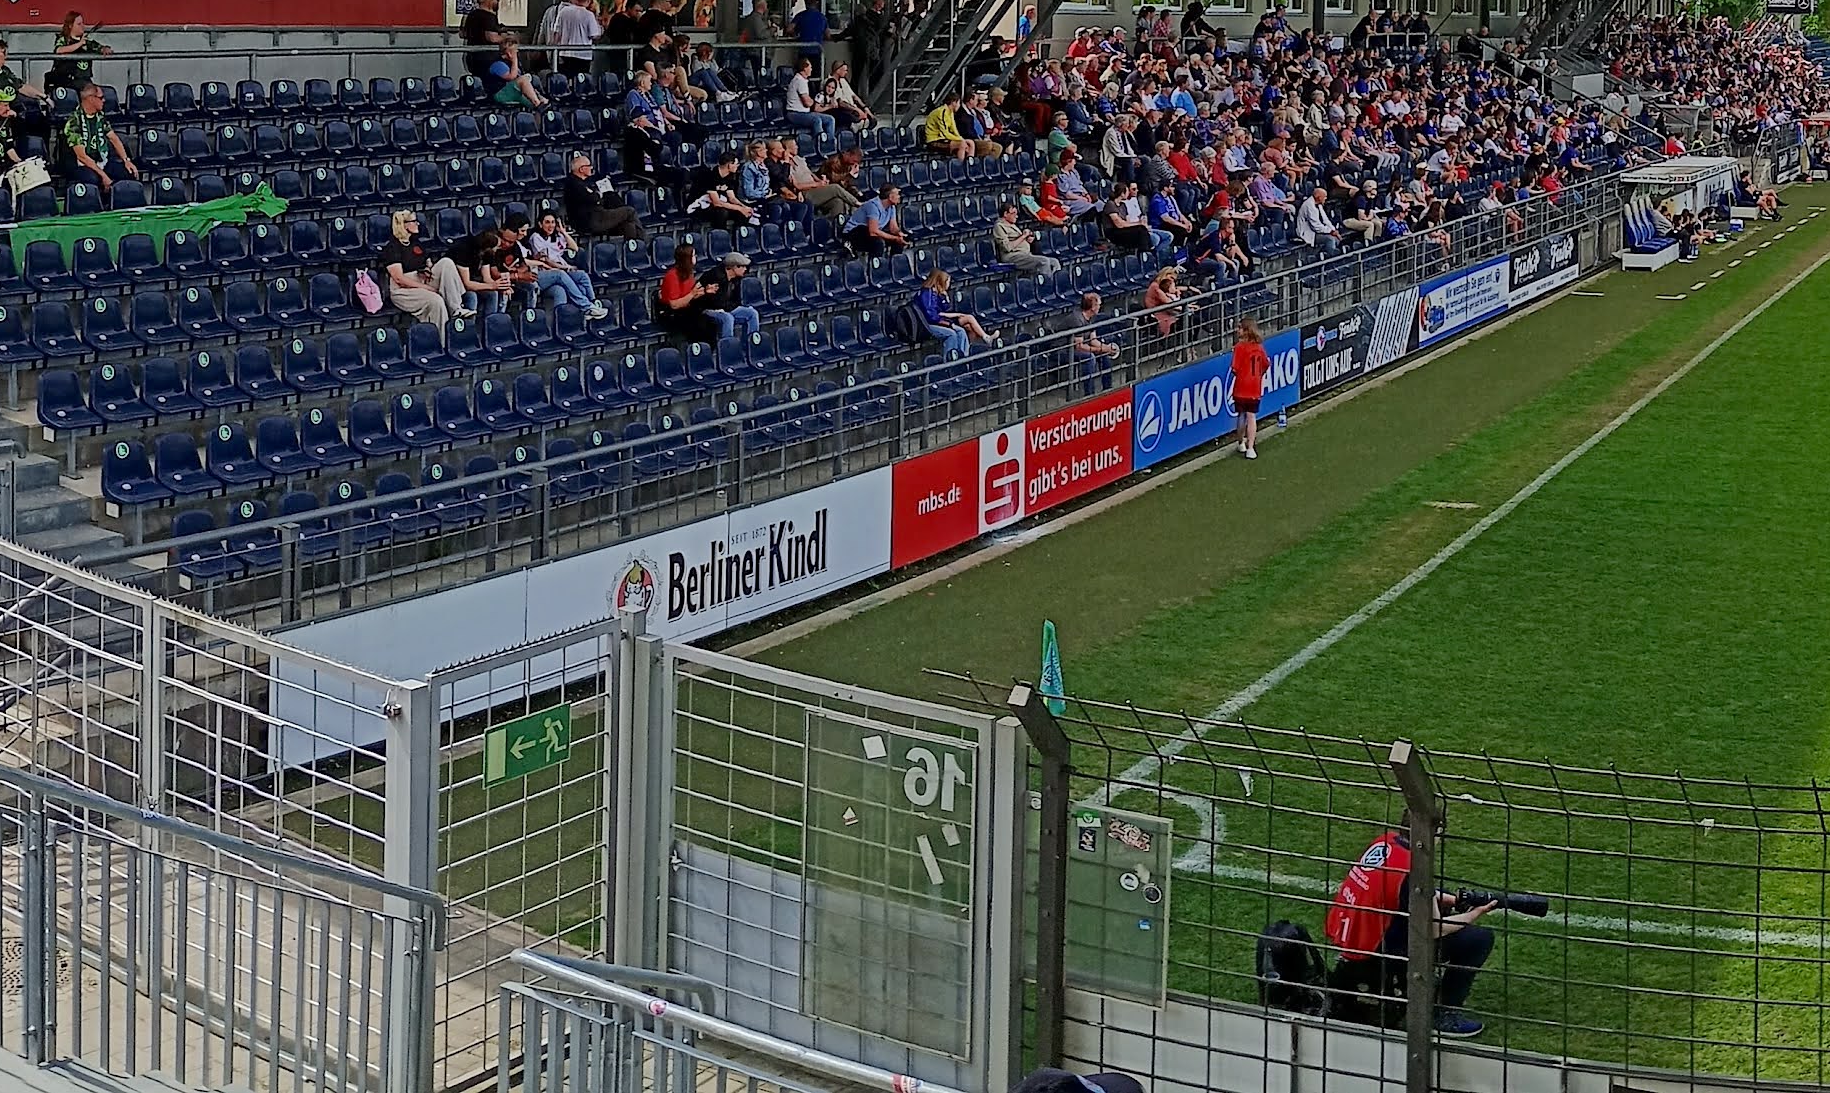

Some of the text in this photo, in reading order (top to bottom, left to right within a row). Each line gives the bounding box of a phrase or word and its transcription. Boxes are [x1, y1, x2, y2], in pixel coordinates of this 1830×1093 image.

[1303, 358, 1325, 392] FOLGT
[1325, 354, 1339, 381] UNS
[1029, 401, 1132, 454] Versicherungen
[1168, 375, 1221, 434] JAKO
[1029, 444, 1123, 505] gibt's bei uns.
[731, 526, 767, 545] SEIT 1872
[667, 509, 829, 621] Berliner Kindl
